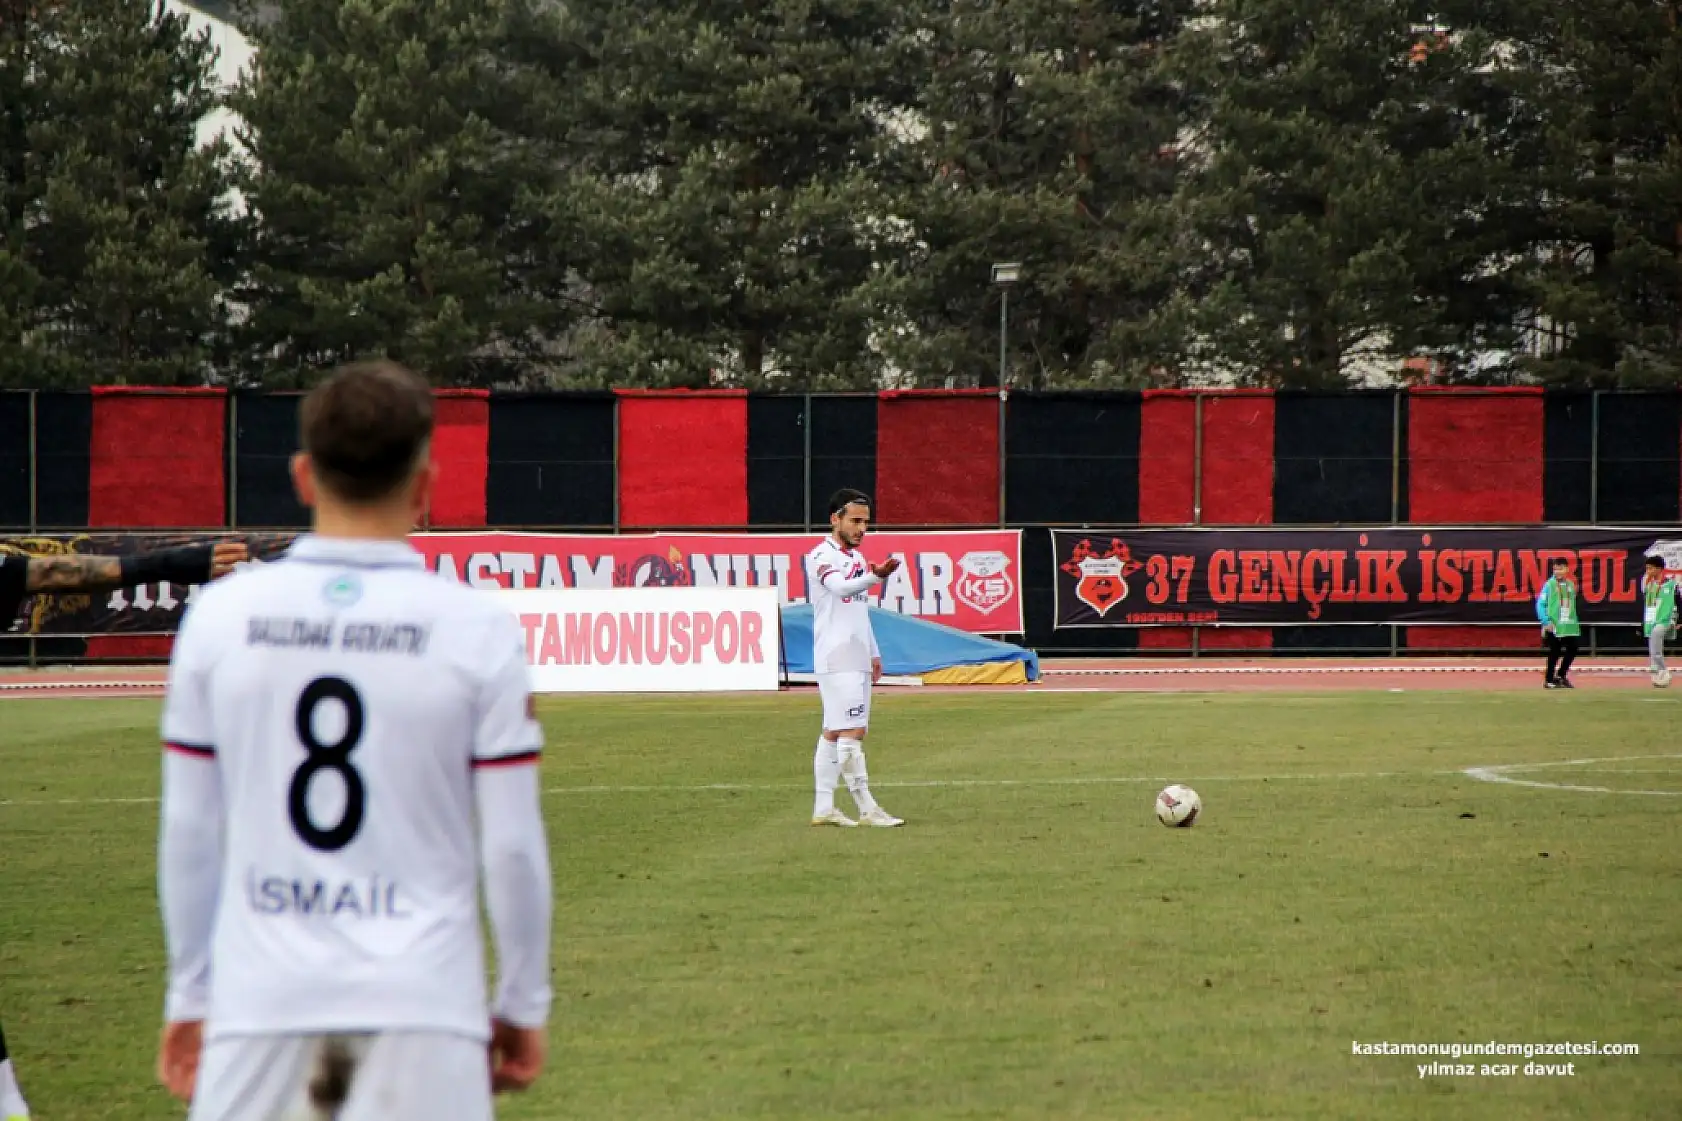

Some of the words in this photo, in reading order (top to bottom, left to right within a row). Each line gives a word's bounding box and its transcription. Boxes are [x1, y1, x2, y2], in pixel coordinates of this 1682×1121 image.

[1146, 554, 1196, 604] 37
[1208, 533, 1407, 619] GENÇLİK
[512, 610, 764, 665] TAMONUSPOR
[287, 675, 366, 852] 8
